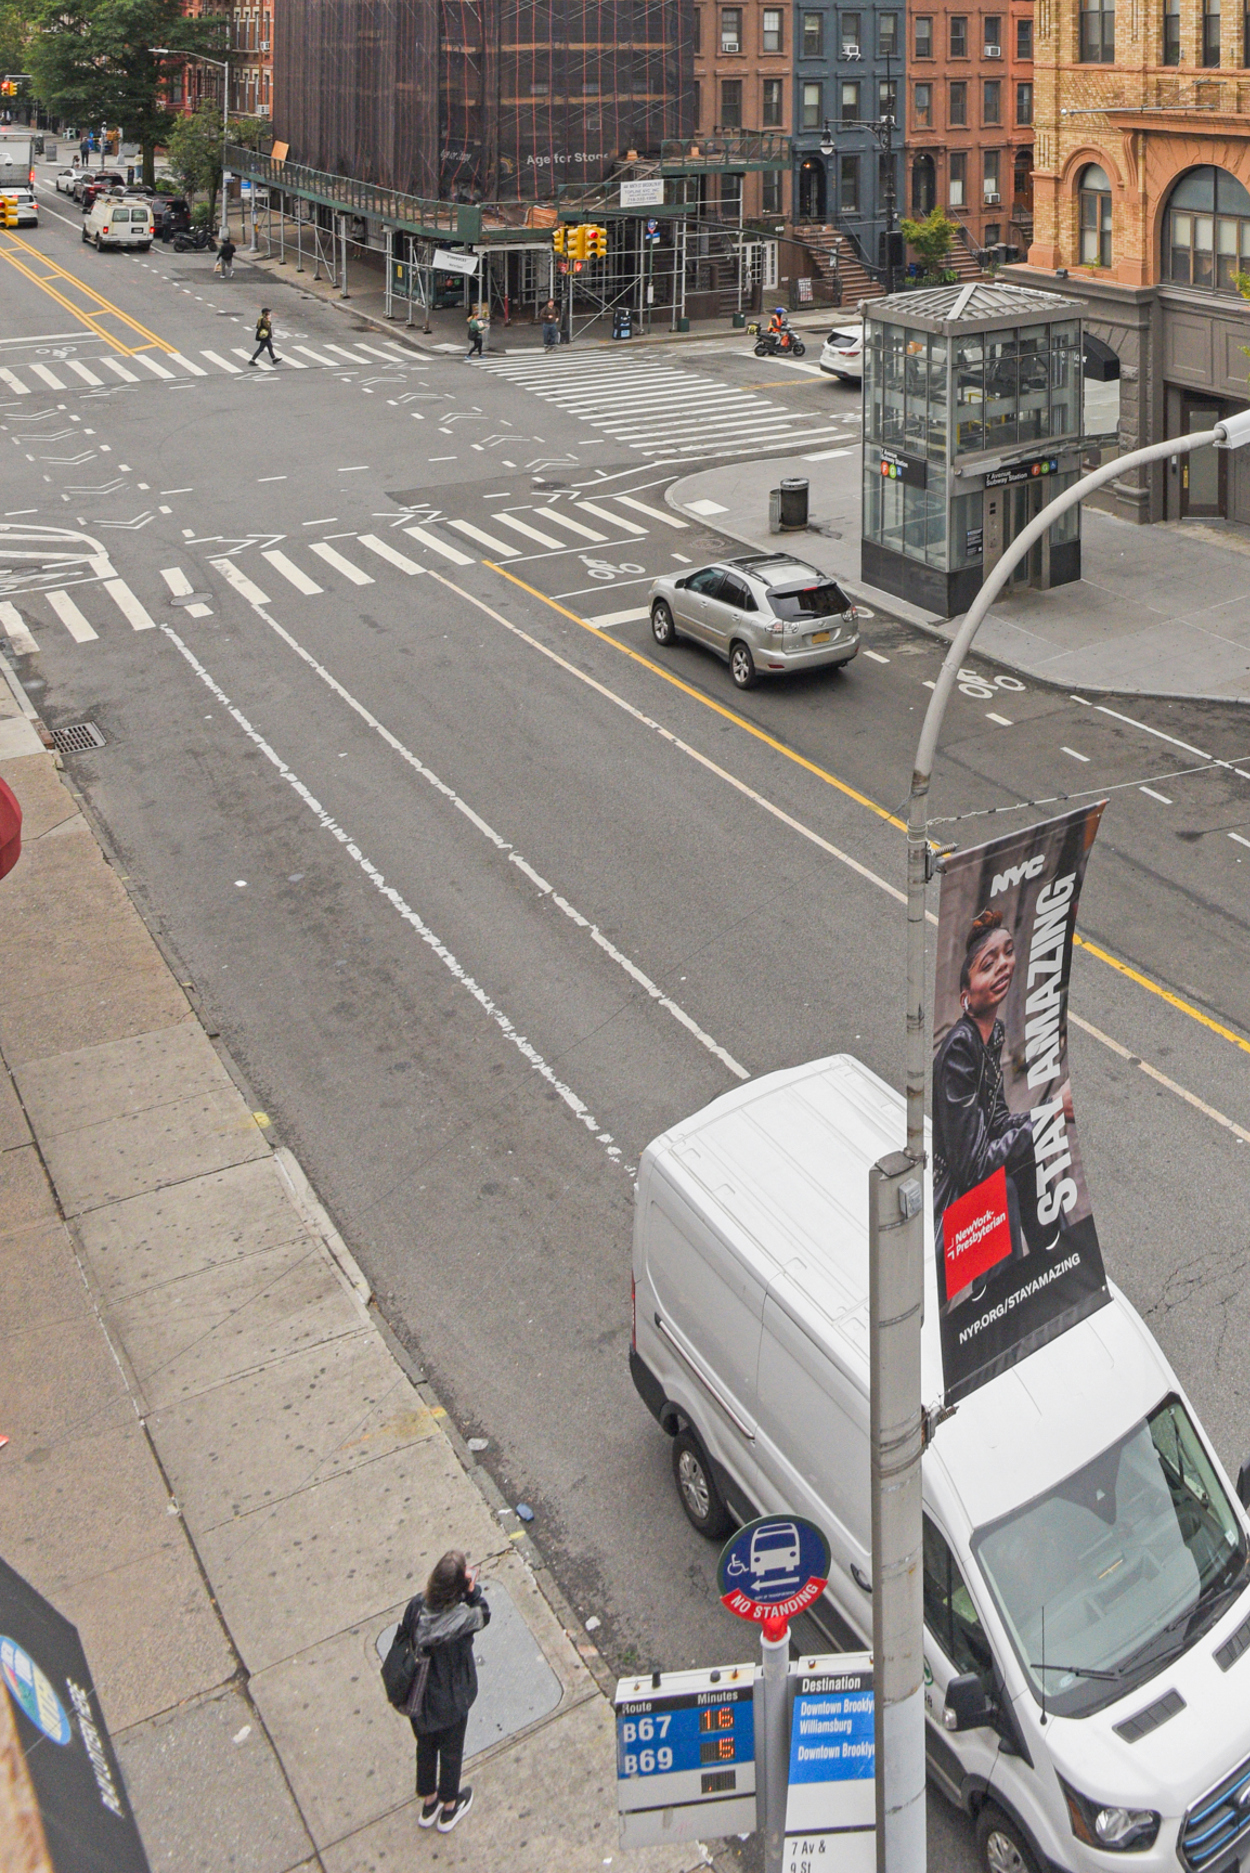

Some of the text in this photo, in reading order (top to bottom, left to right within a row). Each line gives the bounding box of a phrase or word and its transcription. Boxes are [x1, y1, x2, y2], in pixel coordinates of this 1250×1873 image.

[526, 155, 550, 167] Age
[554, 153, 571, 164] for
[986, 472, 1028, 487] Subway Station
[990, 471, 1011, 479] Avenue
[990, 854, 1046, 898] NYC
[1024, 872, 1078, 1226] STAY AMAZING
[955, 1212, 1007, 1257] Presbyterian
[958, 1252, 1081, 1345] NYP.ORG/STAYAMAZING
[731, 1584, 820, 1619] NO STANDING
[802, 1676, 861, 1694] Destination
[622, 1690, 738, 1715] Route Minutes
[800, 1695, 874, 1716] Downtown Brookly
[623, 1707, 734, 1743] B67 16
[799, 1718, 853, 1735] Williamsburg
[624, 1737, 735, 1775] B69 5
[798, 1741, 875, 1762] Downtown Brookly
[791, 1840, 826, 1856] 7 Av &
[790, 1861, 812, 1873] 9 St
